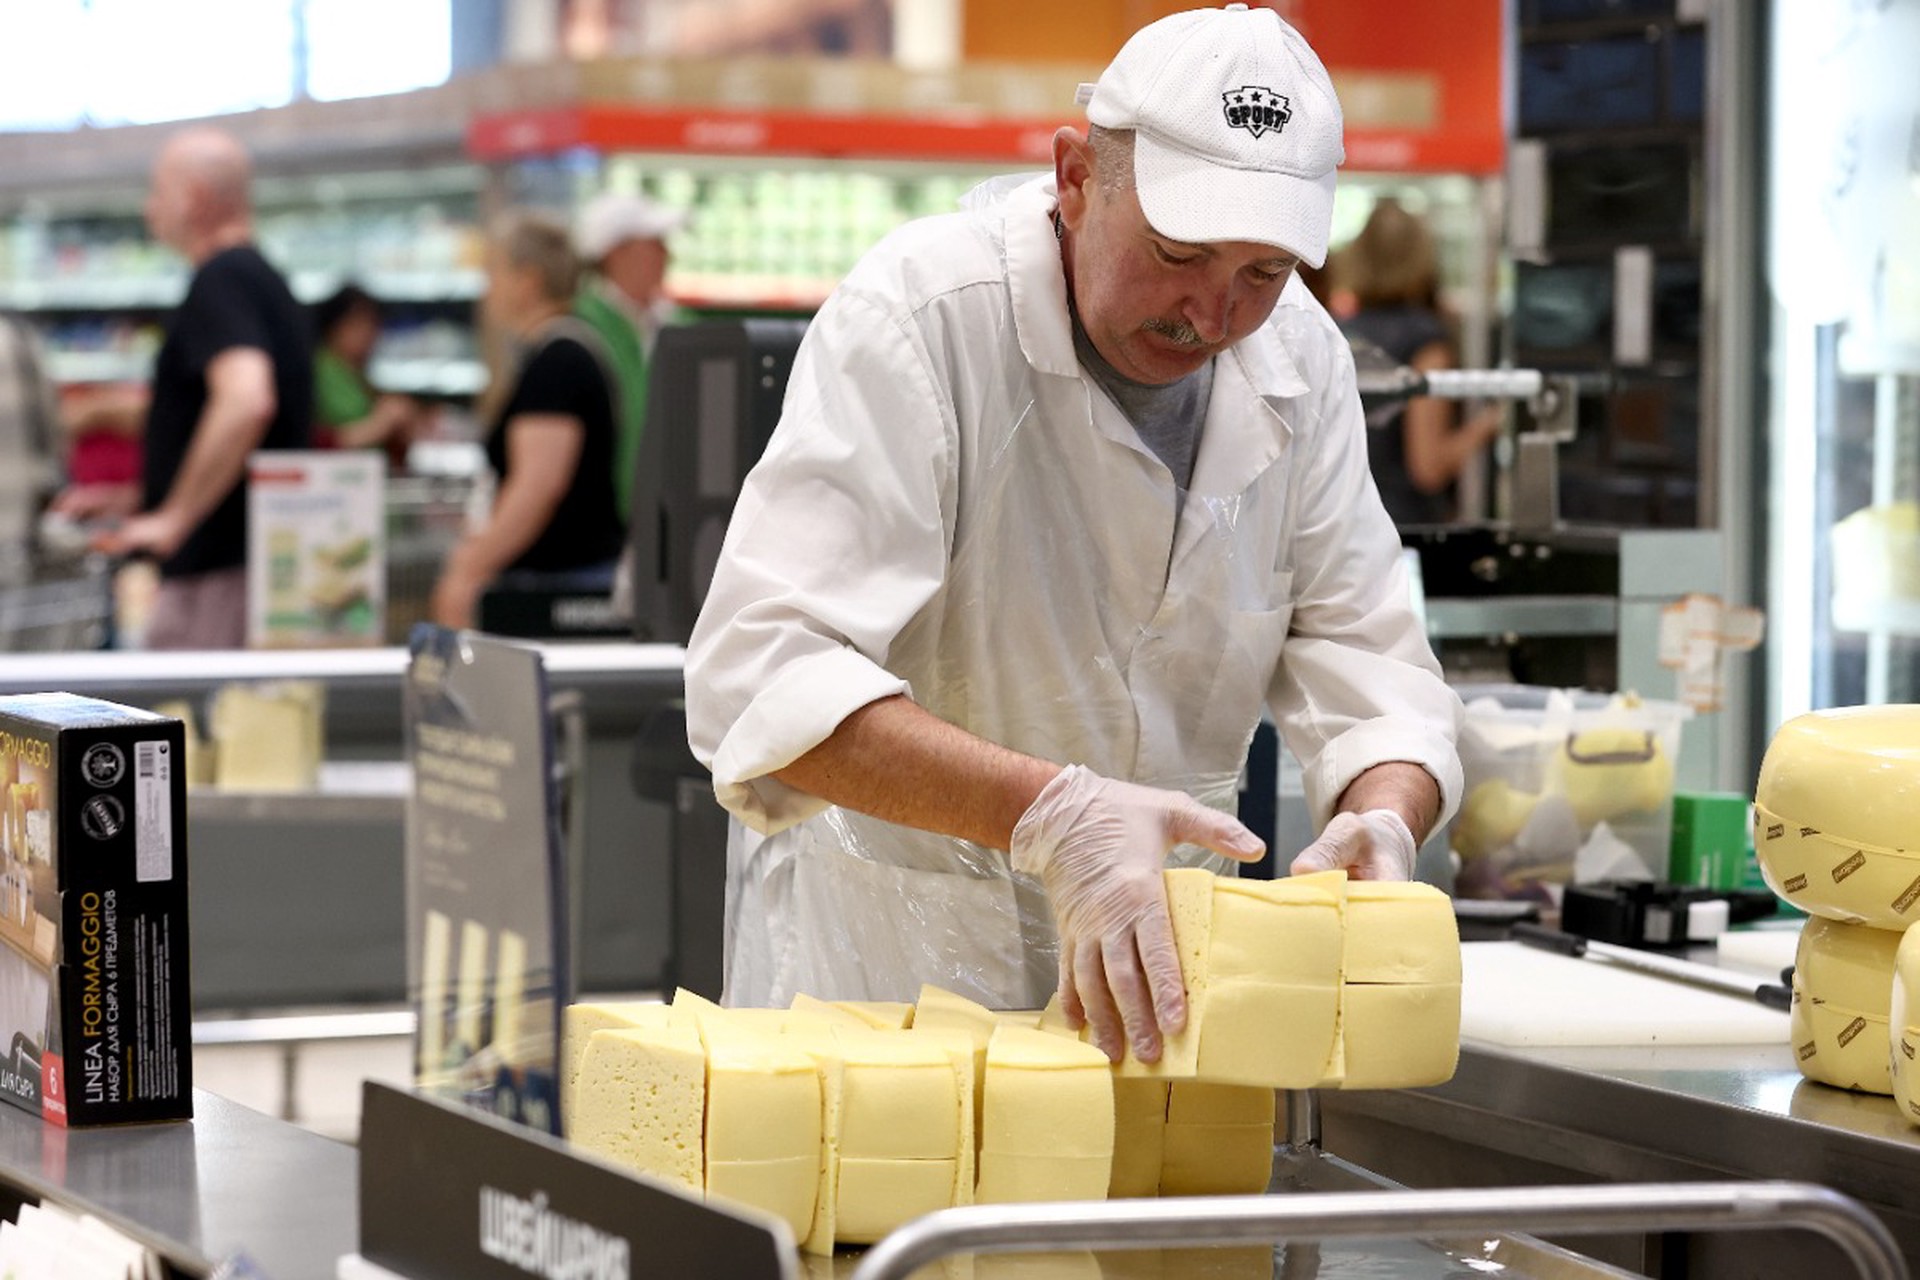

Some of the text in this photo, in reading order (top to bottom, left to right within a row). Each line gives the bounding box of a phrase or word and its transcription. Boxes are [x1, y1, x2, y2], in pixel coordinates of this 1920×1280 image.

[1228, 104, 1287, 128] SPORT
[0, 731, 50, 768] ORMAGGIO
[81, 892, 103, 1103] LINEA FORMAGGIO
[104, 889, 120, 1102] НАБОР ДЛЯ СЫРА 6 ПРЕДМЕТОВ
[49, 1067, 58, 1095] 6
